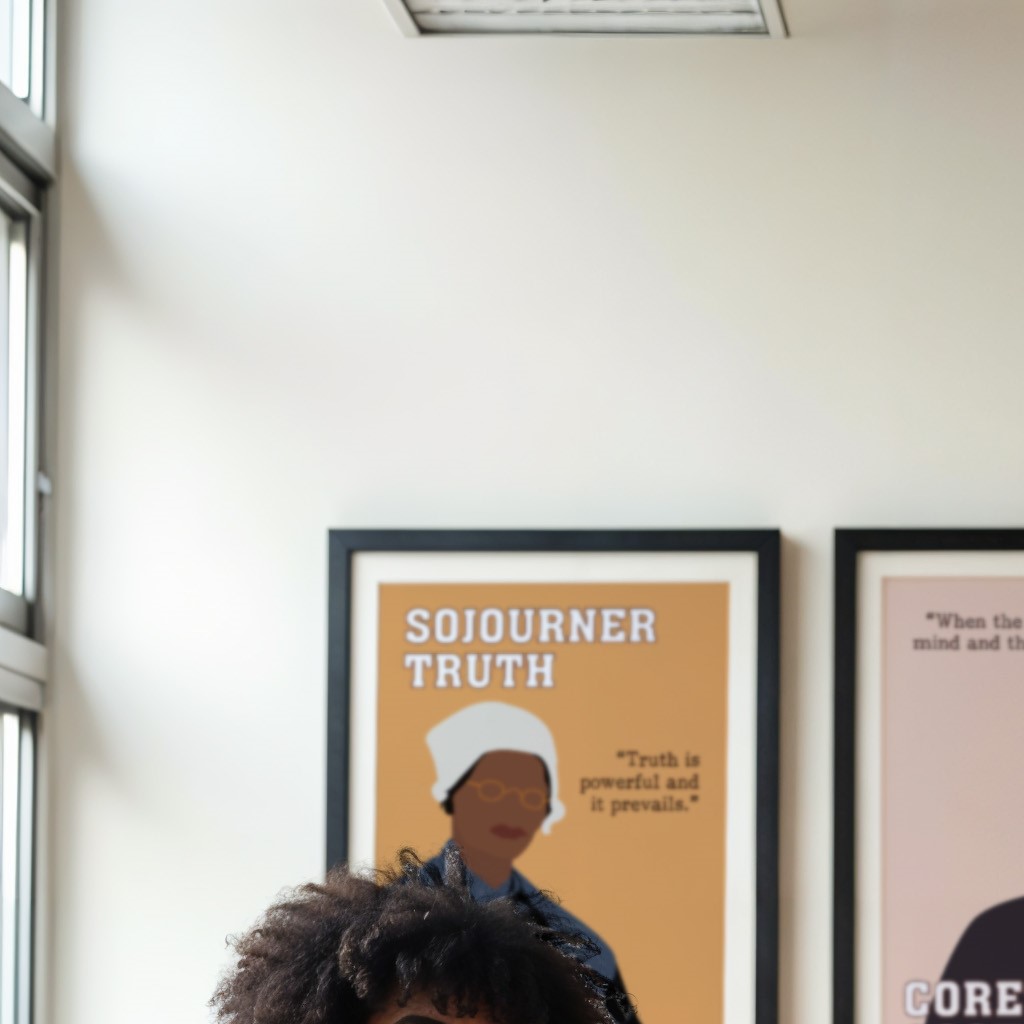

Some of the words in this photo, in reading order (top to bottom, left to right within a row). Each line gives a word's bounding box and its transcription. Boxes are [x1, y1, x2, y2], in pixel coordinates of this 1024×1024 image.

[405, 607, 656, 644] SOJOURNER
[993, 613, 1022, 630] the
[913, 635, 959, 651] mind
[967, 635, 999, 651] and
[404, 653, 555, 689] TRUTH
[685, 751, 700, 768] is
[580, 773, 659, 794] powerful
[666, 773, 700, 790] and
[591, 796, 604, 812] it
